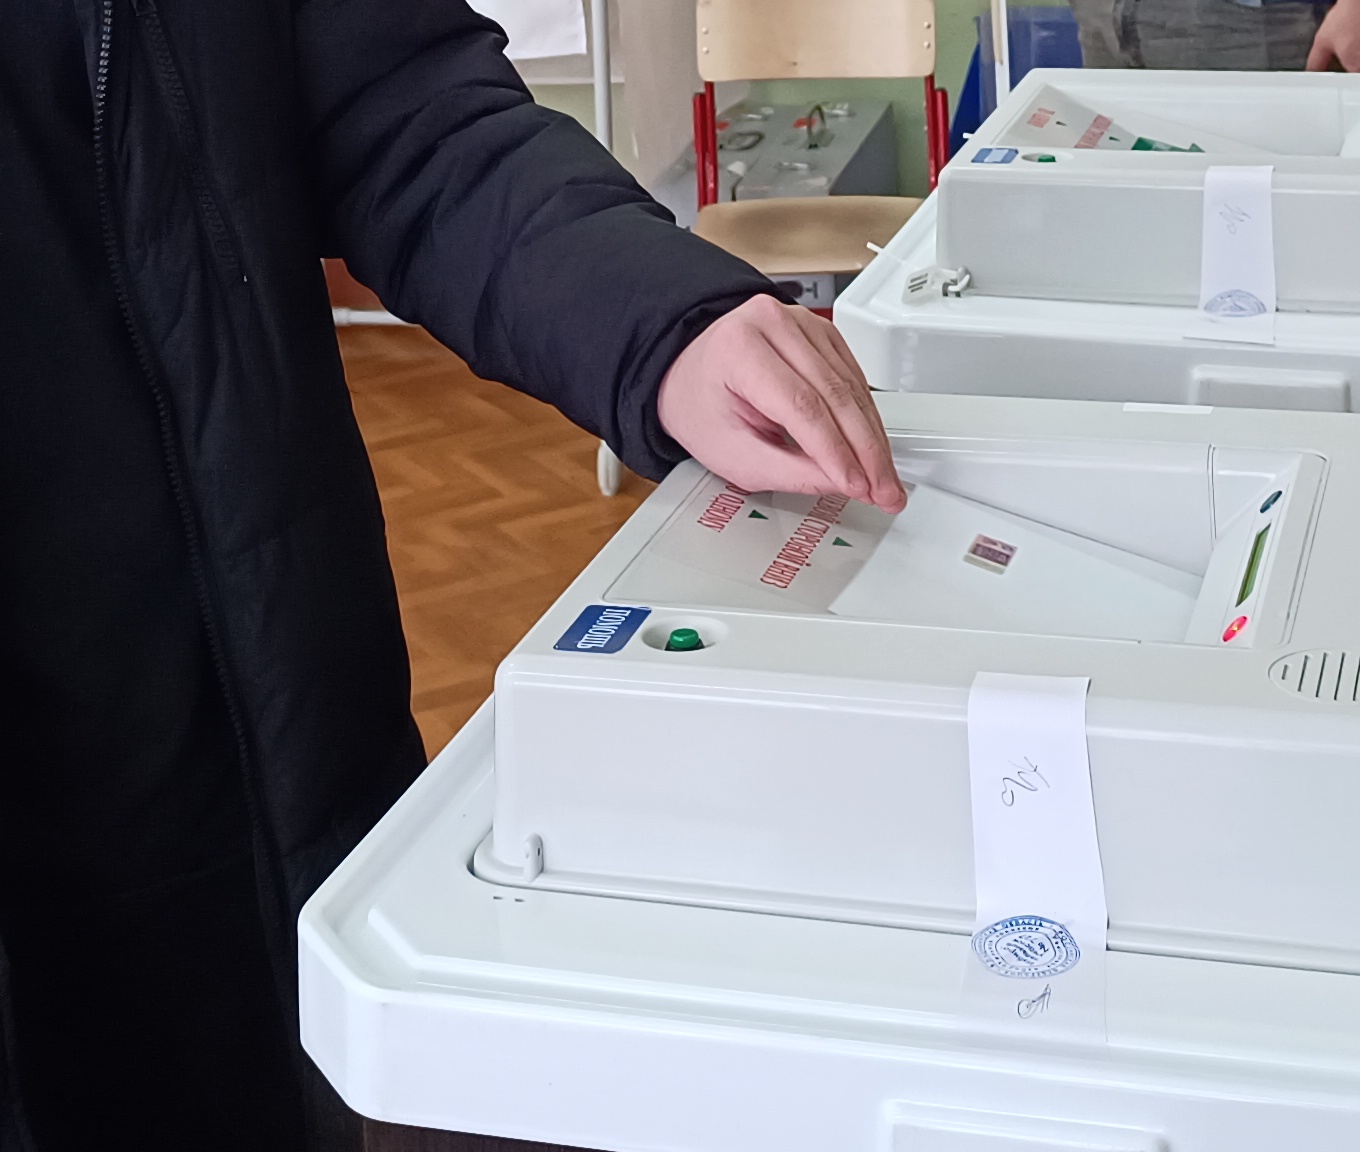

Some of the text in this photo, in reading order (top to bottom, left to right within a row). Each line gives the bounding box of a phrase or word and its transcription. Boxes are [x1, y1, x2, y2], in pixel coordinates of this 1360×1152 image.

[776, 517, 831, 567] СТОРОНОЙ
[759, 559, 801, 589] ВНИЗ
[576, 608, 632, 649] ПОМОЩЬ
